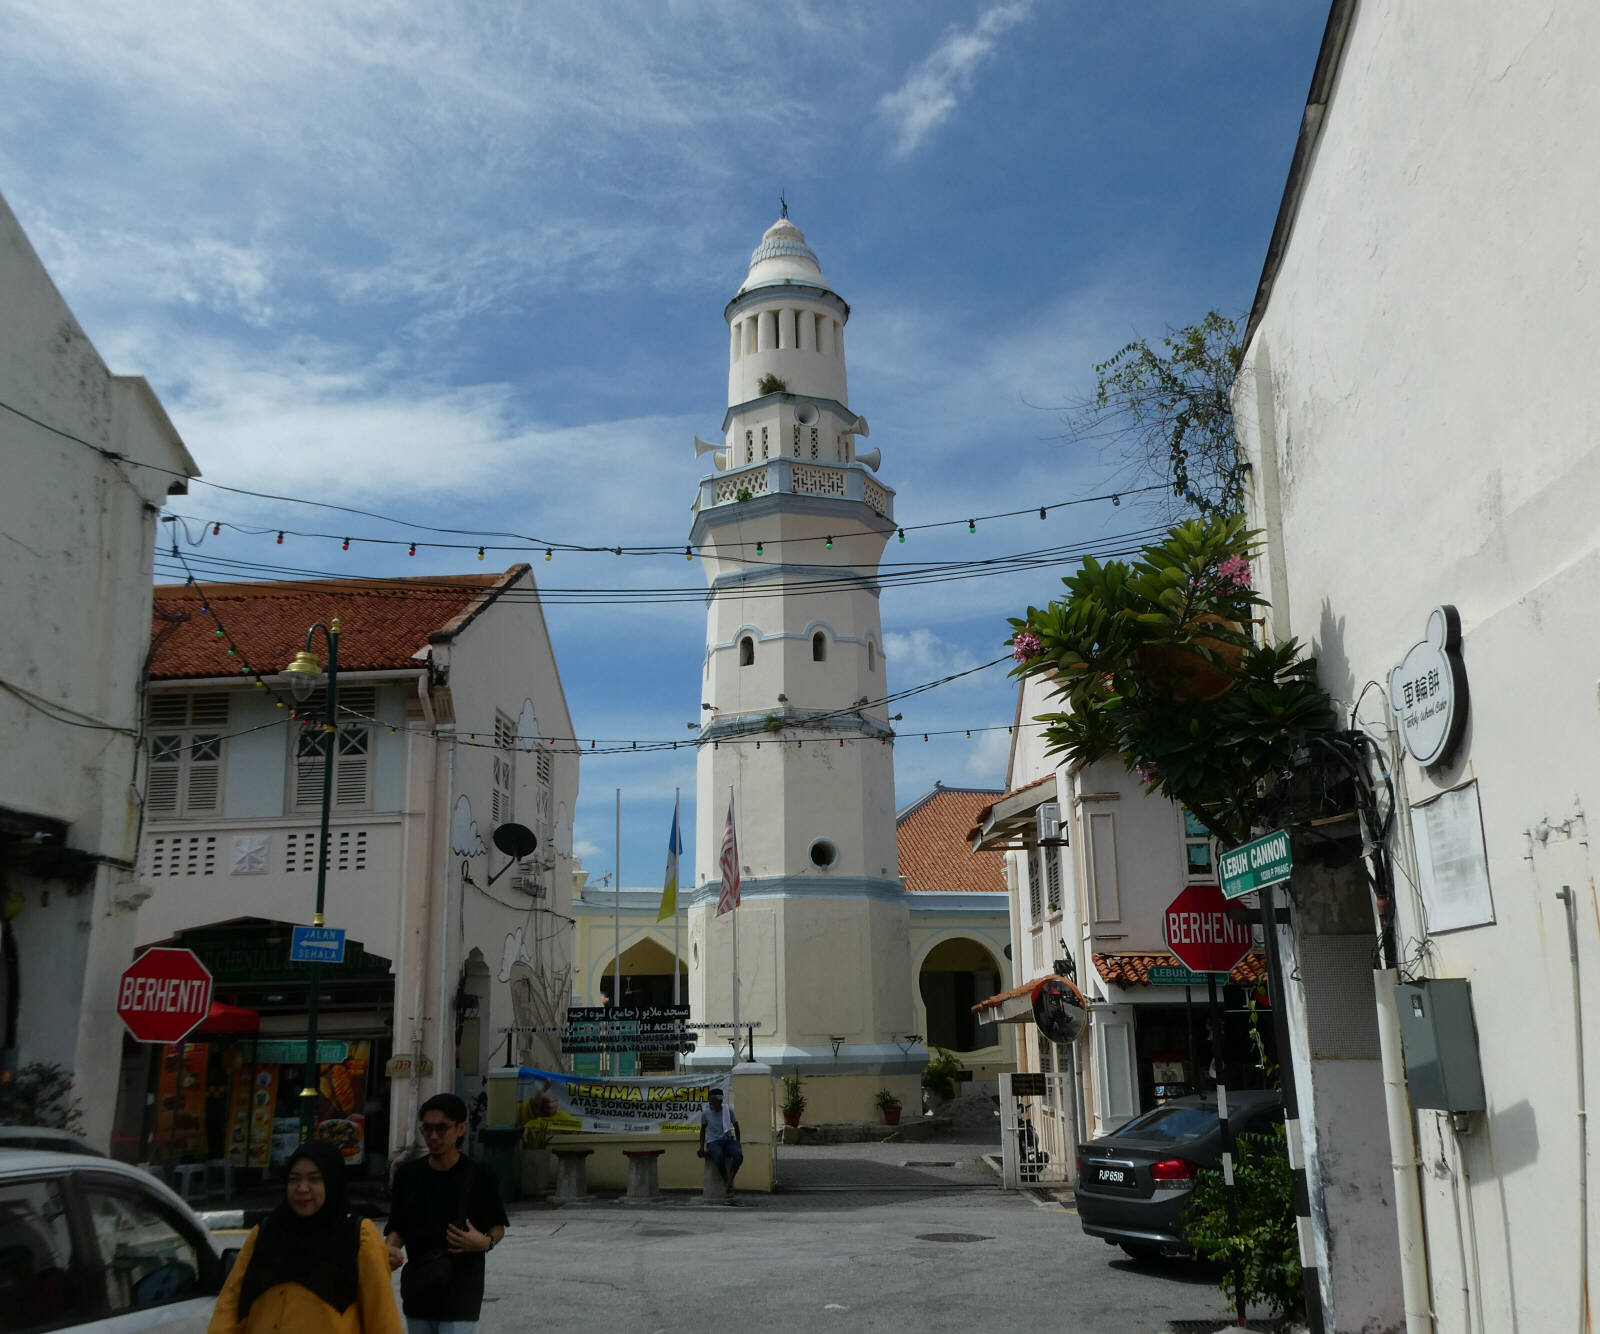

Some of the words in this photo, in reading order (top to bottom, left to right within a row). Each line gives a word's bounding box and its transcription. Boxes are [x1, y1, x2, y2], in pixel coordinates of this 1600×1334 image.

[1402, 667, 1440, 709] 車輪餅
[1223, 852, 1249, 880] LEBUH
[1251, 836, 1287, 869] CANNON
[304, 930, 336, 940] JALAN
[297, 951, 337, 961] SEHALA
[120, 977, 206, 1014] BERHENTI
[566, 1082, 643, 1101] TERIMA
[647, 1085, 709, 1103] KASIH
[570, 1098, 599, 1108] ATAS
[600, 1101, 663, 1112] SOKONGAN
[665, 1103, 704, 1113] SEMUA
[584, 1108, 635, 1118] SEPANJANG
[637, 1111, 666, 1120] TAHUN
[668, 1113, 689, 1121] 2024
